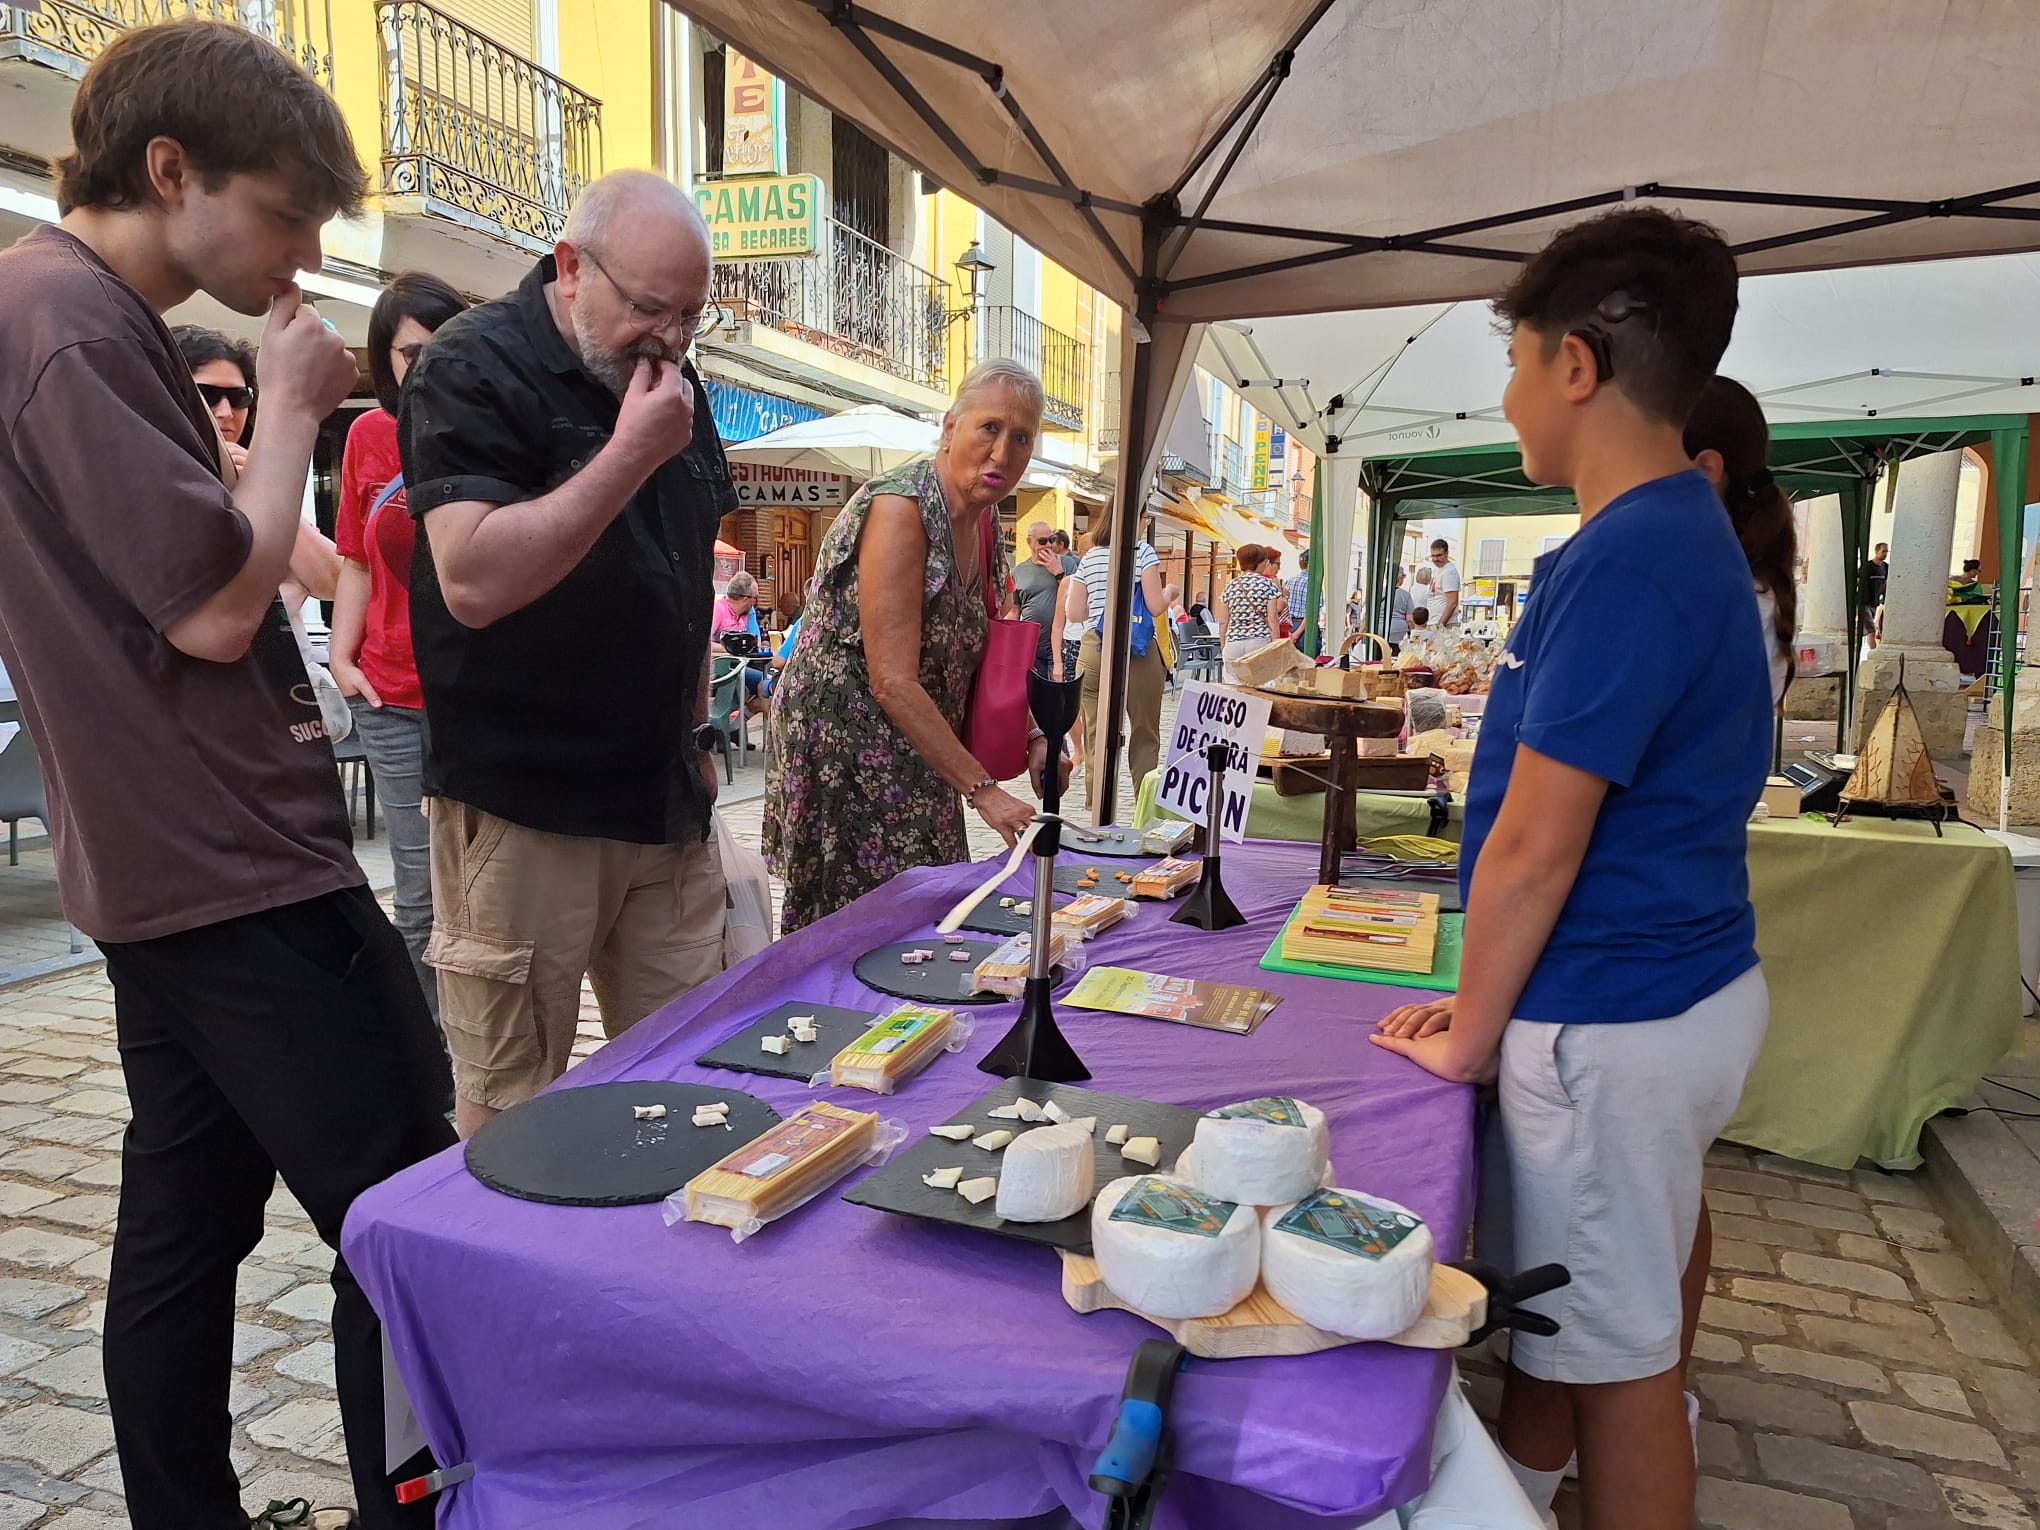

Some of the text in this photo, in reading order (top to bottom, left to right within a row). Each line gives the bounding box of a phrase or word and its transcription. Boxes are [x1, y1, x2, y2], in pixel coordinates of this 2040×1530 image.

[695, 183, 806, 225] CAMAS
[740, 226, 808, 250] BECARES
[738, 484, 820, 502] CAMAS
[1197, 691, 1247, 729] QUESO
[1176, 724, 1249, 774] DE CRA
